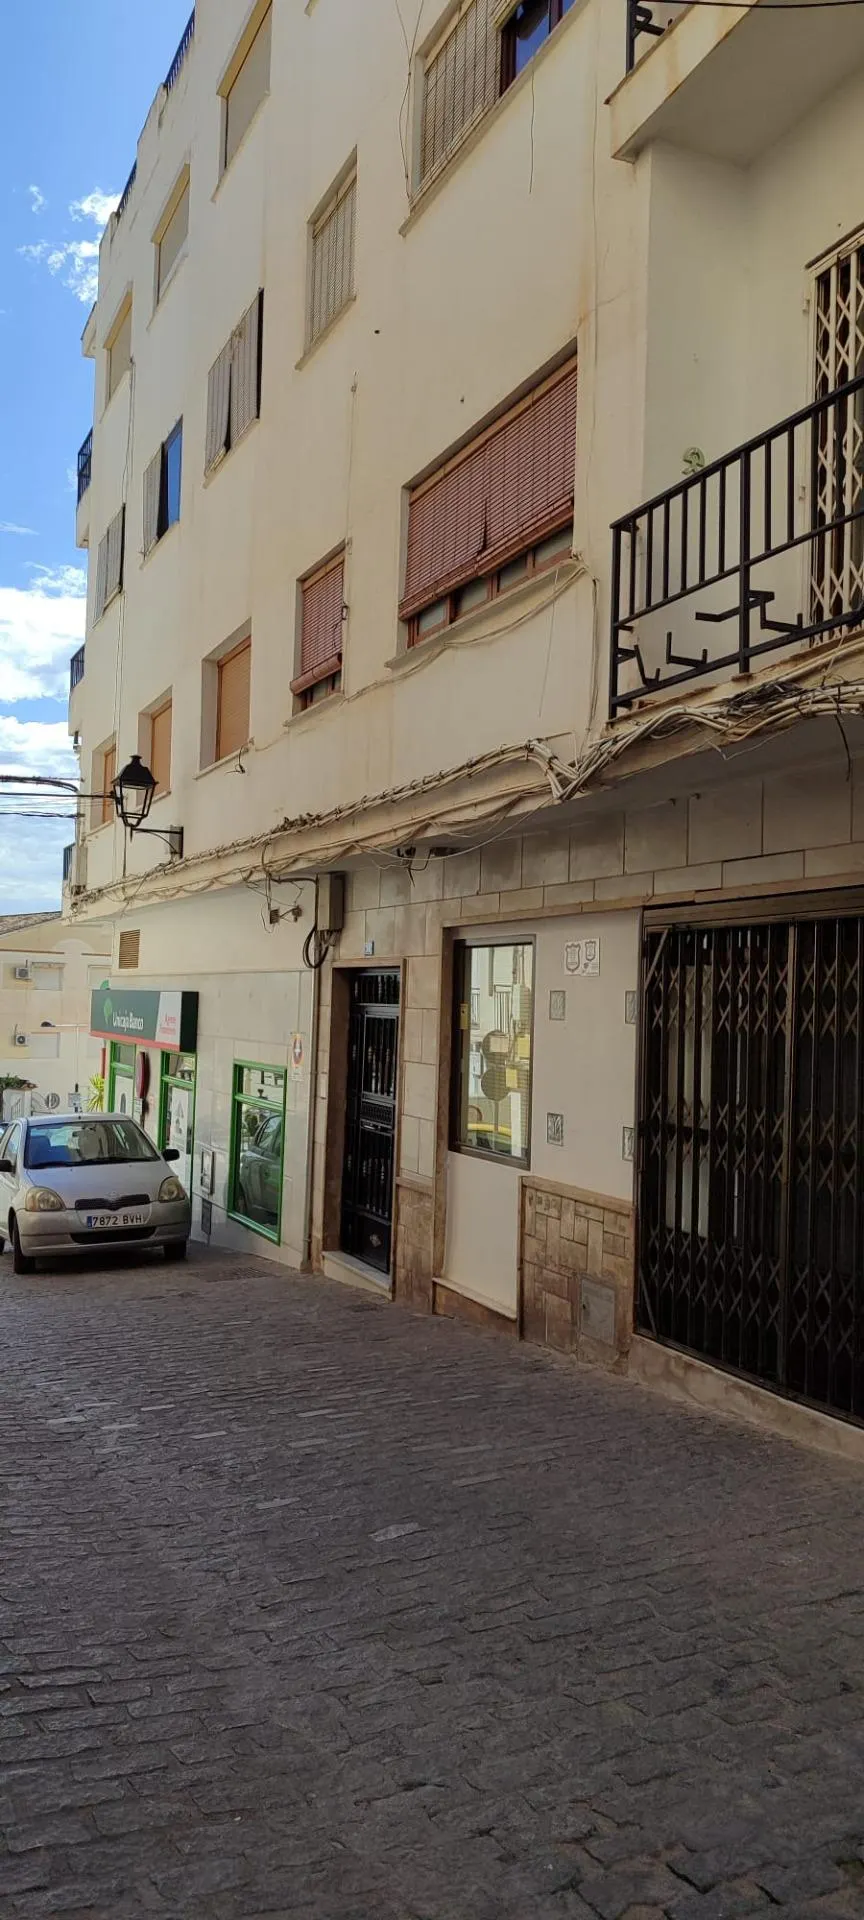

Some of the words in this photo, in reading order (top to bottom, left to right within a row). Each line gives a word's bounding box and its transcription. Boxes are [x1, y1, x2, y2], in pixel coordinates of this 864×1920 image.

[129, 1012, 144, 1030] Banco
[92, 1216, 119, 1227] 7872
[122, 1214, 142, 1225] BVH
